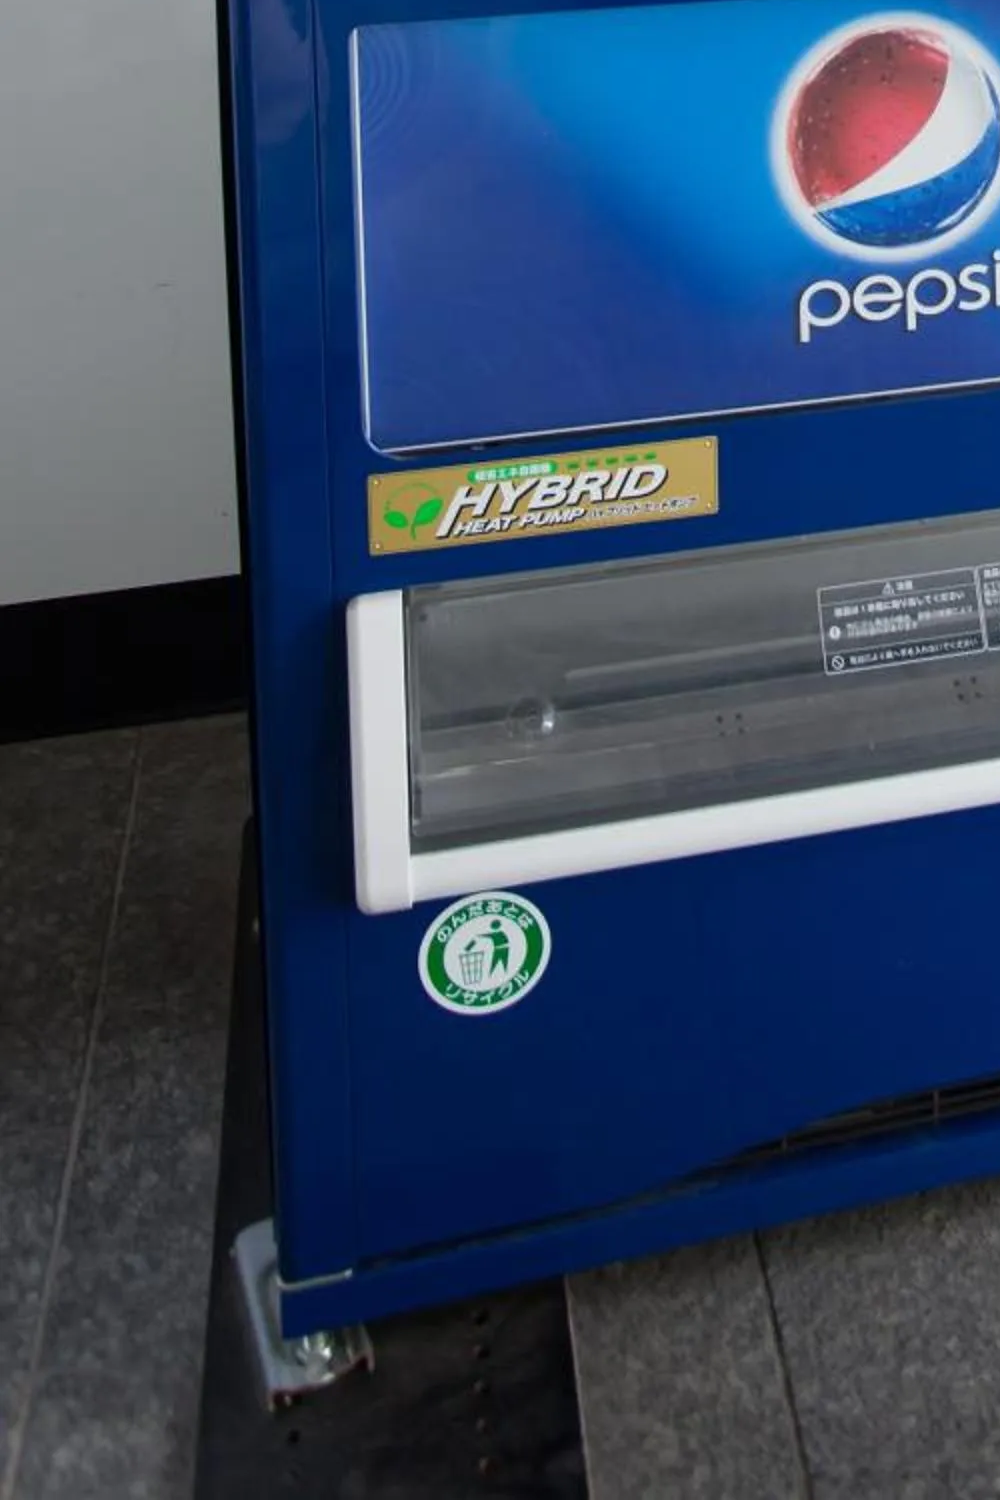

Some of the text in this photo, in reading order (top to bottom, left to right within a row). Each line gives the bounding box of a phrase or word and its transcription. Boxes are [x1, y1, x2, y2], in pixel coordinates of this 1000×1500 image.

[435, 464, 668, 538] HYBRID
[453, 516, 514, 536] HEAT
[520, 507, 587, 528] PUMP
[445, 969, 530, 1005] リサイクル
